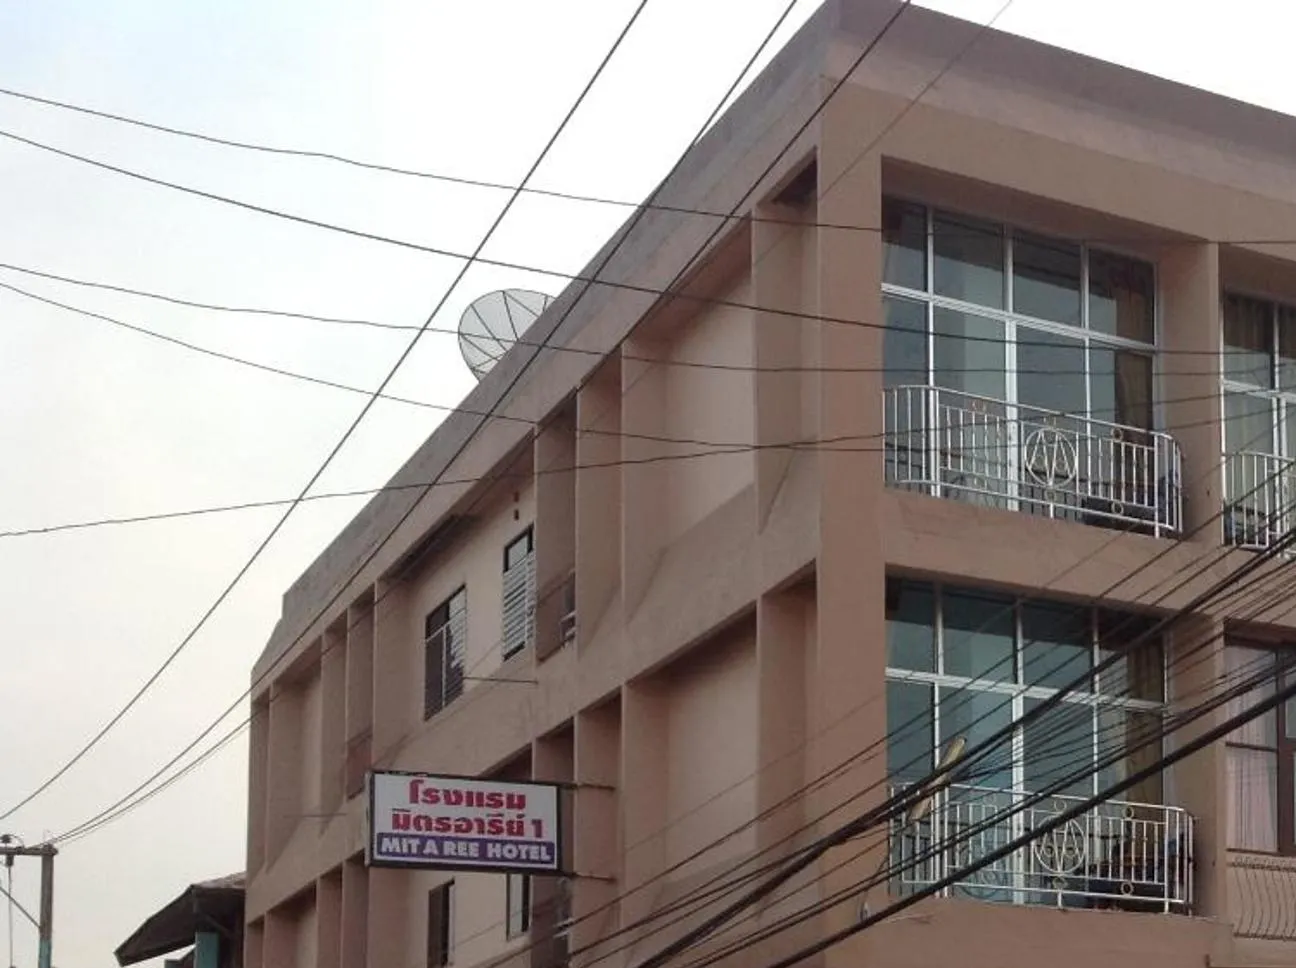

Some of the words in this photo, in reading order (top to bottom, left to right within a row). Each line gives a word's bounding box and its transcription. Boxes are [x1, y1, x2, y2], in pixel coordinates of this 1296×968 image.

[409, 779, 526, 810] โรงแรม
[486, 843, 551, 861] HOTEL
